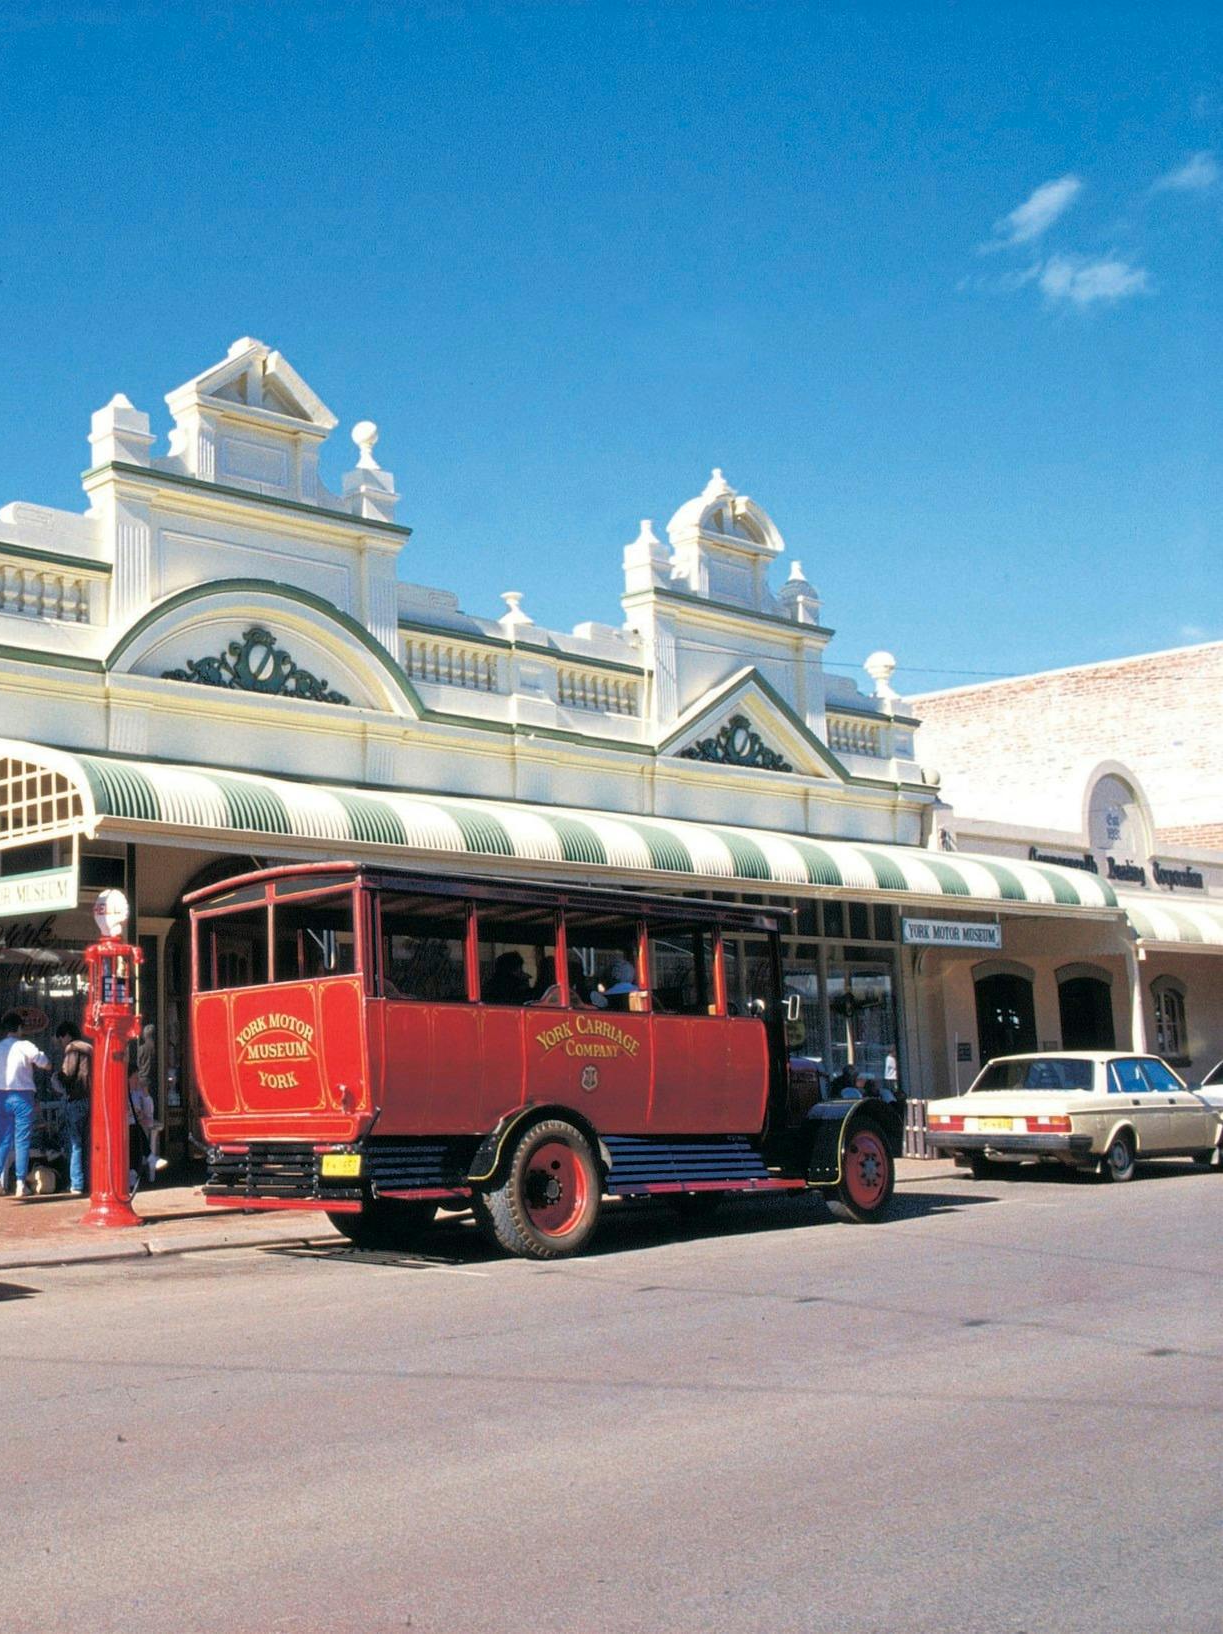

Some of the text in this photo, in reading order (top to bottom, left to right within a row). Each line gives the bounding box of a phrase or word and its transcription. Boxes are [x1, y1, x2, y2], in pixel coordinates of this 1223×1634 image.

[17, 880, 67, 903] MUSEUM
[909, 923, 996, 943] YORK MOTOR MUSEUM
[235, 1012, 315, 1048] YORK MOTOR
[536, 1021, 574, 1051] YORK
[247, 1040, 309, 1061] MUSEUM
[258, 1070, 299, 1090] YORK
